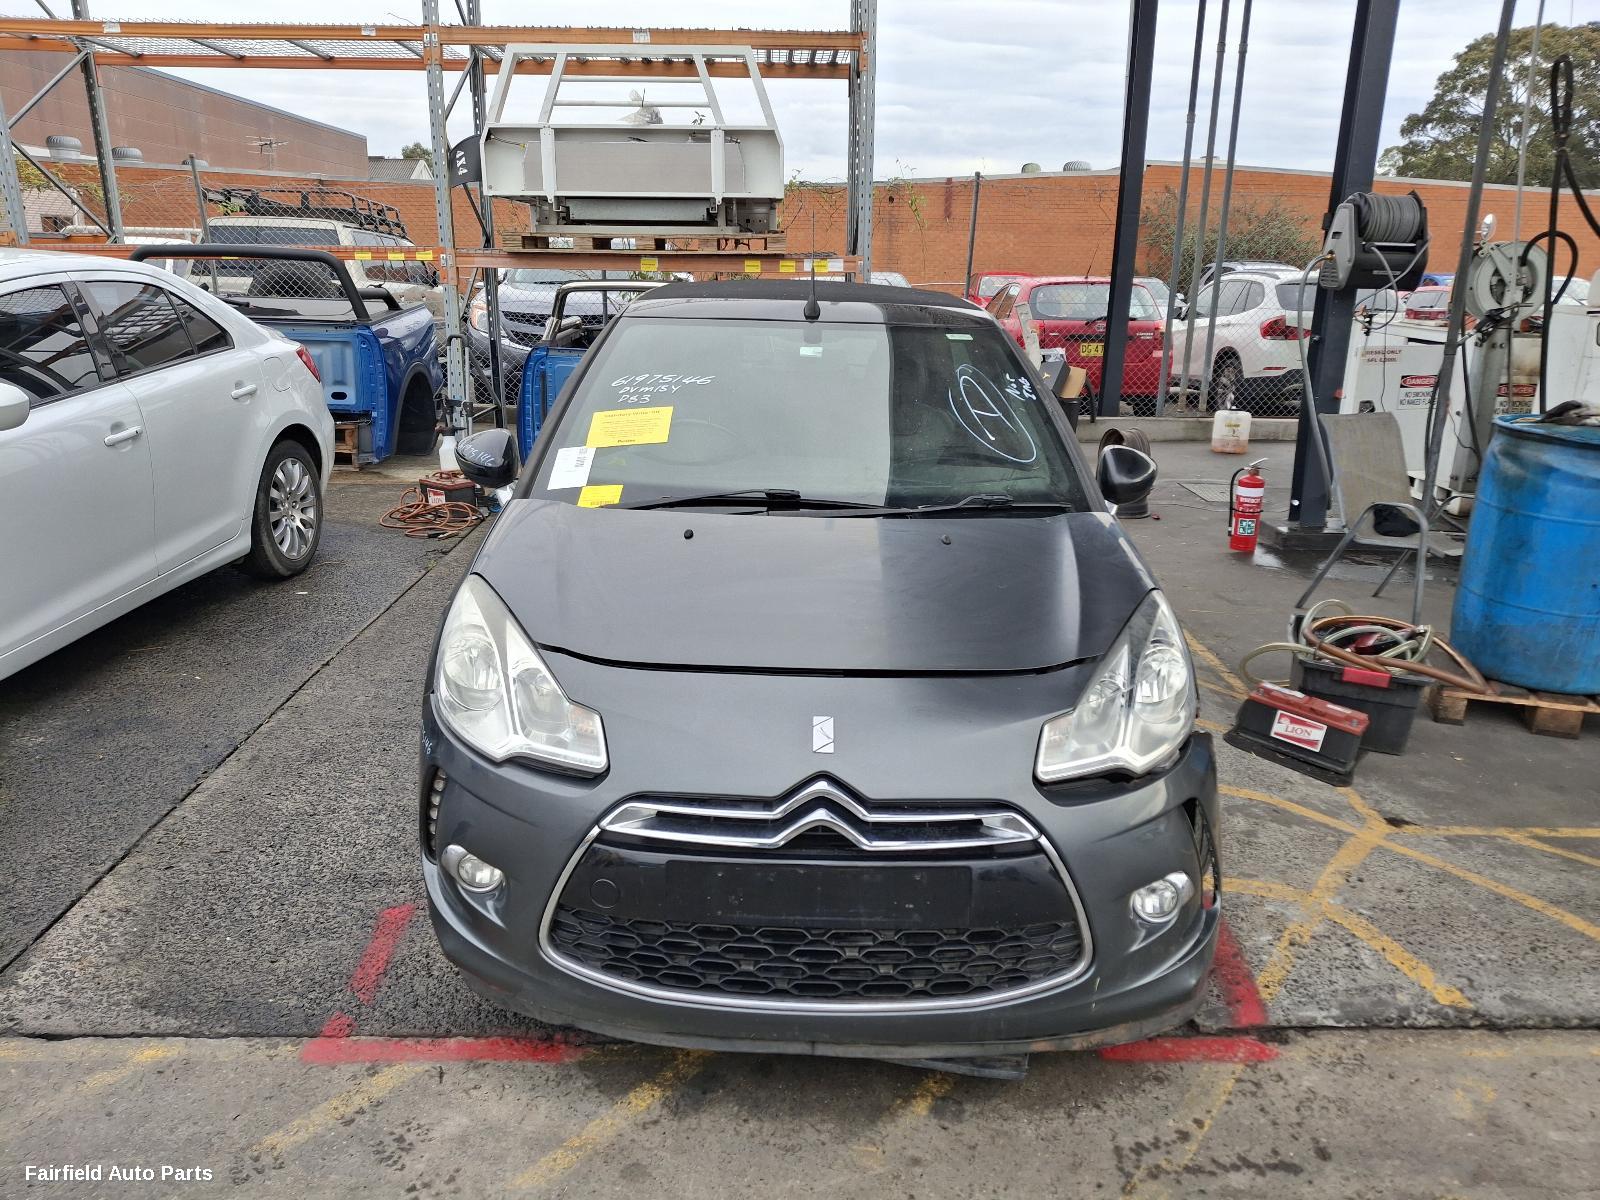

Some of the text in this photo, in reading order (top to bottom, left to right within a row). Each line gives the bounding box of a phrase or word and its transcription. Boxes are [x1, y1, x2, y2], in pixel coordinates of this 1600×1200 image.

[611, 373, 716, 387] 61975146
[1405, 377, 1436, 385] DANGER
[1285, 724, 1313, 737] LION
